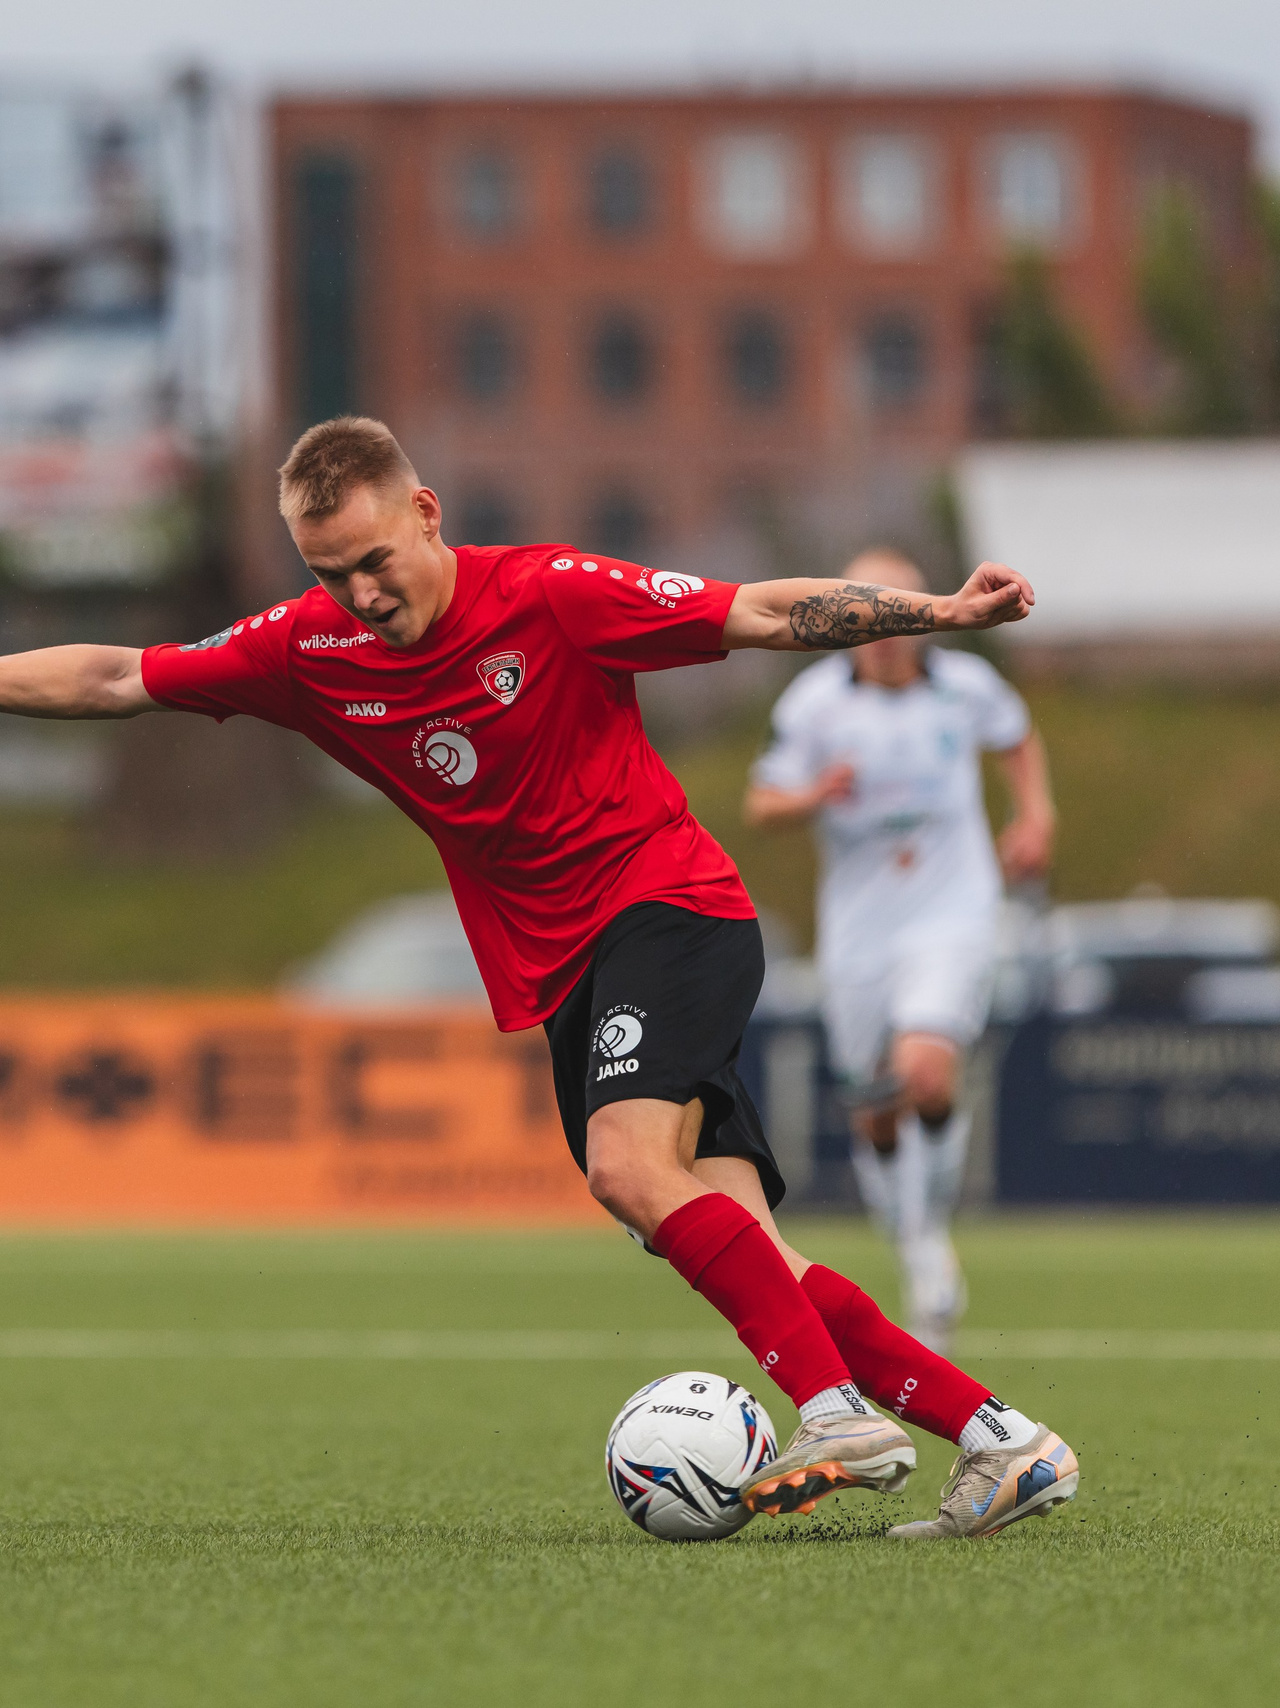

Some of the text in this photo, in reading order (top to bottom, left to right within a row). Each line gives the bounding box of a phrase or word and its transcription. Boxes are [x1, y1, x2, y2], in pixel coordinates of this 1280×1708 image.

[298, 631, 376, 650] wildberries
[344, 702, 387, 717] JAKO
[411, 717, 472, 768] REPIK ACTIVE
[592, 1004, 648, 1053] REPIK ACTIVE
[596, 1058, 640, 1082] JAKO
[647, 1404, 715, 1421] DEMIX
